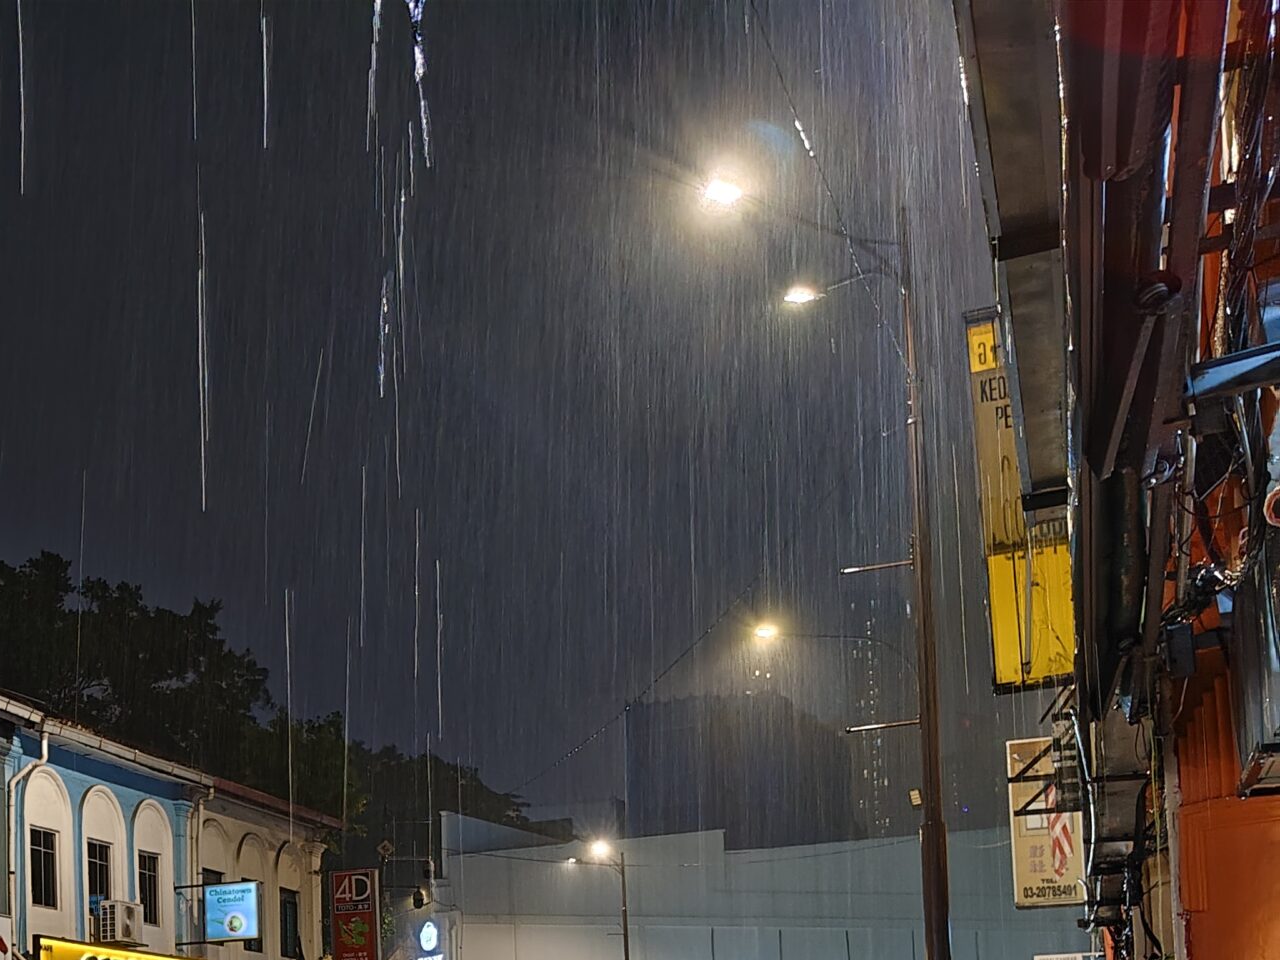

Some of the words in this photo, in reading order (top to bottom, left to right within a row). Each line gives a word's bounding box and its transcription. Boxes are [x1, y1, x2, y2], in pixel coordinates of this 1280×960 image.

[209, 888, 252, 897] Chinatown
[335, 875, 370, 901] 4D
[217, 895, 244, 904] Cendol
